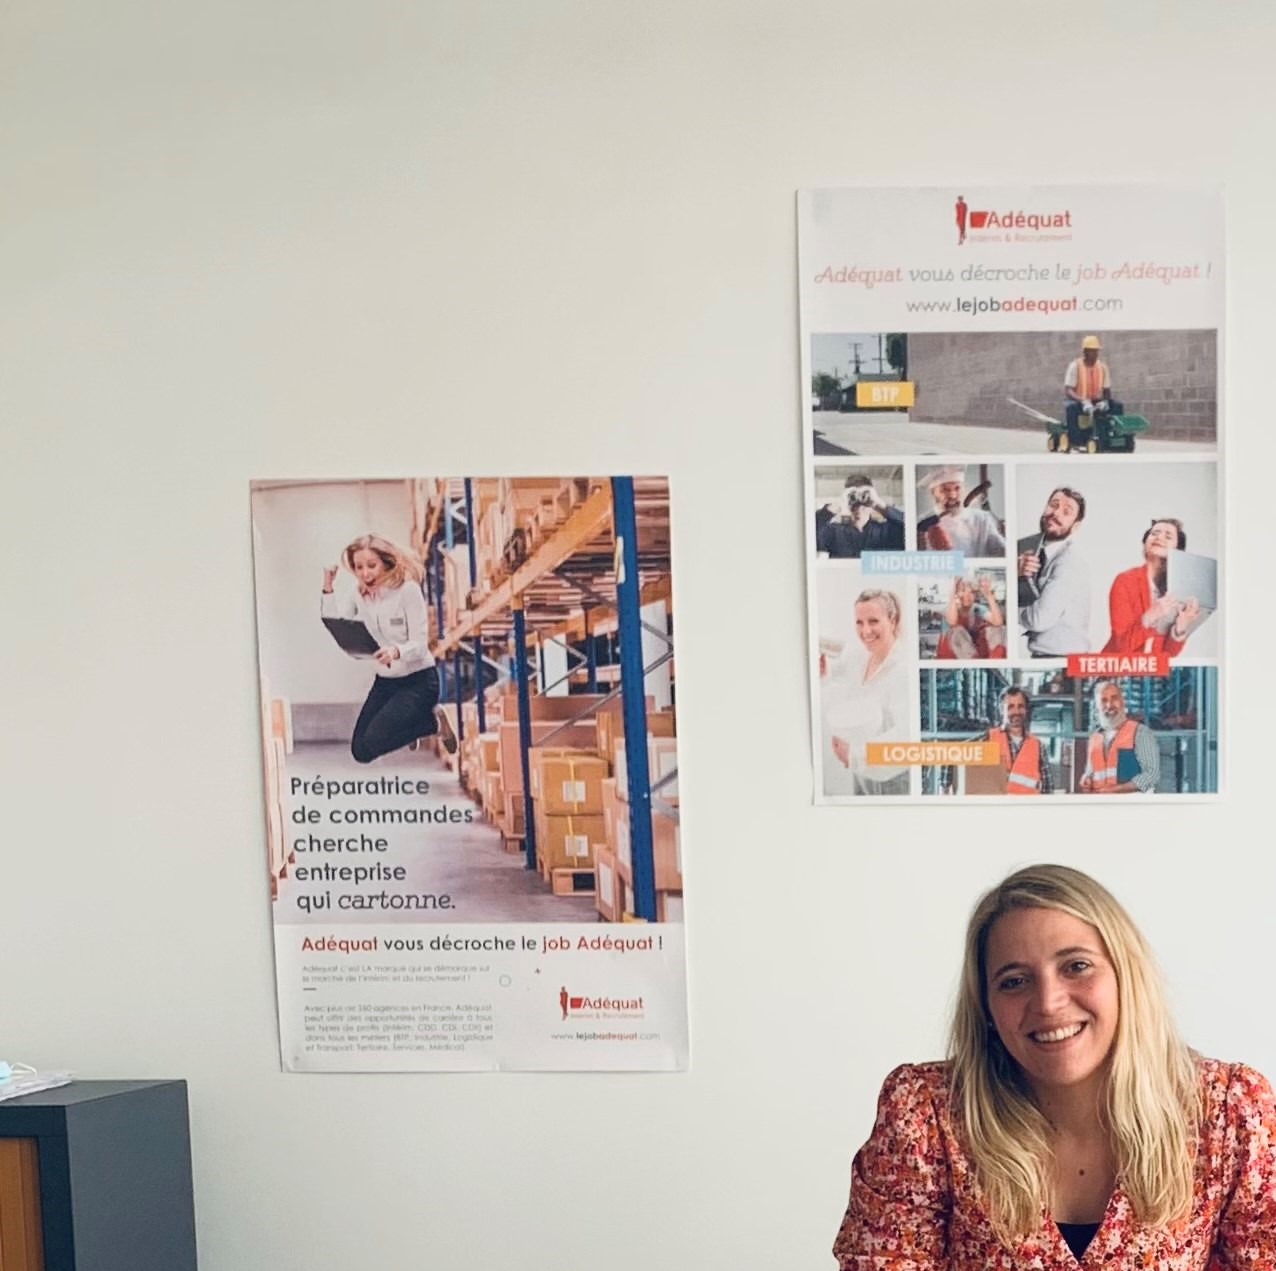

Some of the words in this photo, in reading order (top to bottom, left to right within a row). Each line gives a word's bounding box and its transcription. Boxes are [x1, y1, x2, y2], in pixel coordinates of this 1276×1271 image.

[987, 210, 1072, 231] Adéquat
[814, 266, 903, 289] Adéquat
[908, 267, 955, 283] vous
[960, 264, 1050, 283] décroche
[1056, 265, 1071, 281] le
[1072, 265, 1106, 286] job
[1111, 263, 1200, 286] Adéquat
[1206, 263, 1211, 279] !
[906, 297, 1123, 316] www.lejobadequat.com
[872, 386, 899, 403] BTP
[871, 553, 955, 571] INDUSTRIE
[1079, 656, 1157, 673] TERTIAIRE
[883, 745, 983, 762] LOGISTIQUE
[291, 775, 430, 799] Préparatrice
[292, 805, 321, 824] de
[329, 805, 473, 824] commandes
[293, 834, 388, 852] cherche
[295, 862, 407, 885] entreprise
[297, 891, 331, 913] qui
[338, 890, 456, 910] cartonne.
[302, 935, 378, 954] Adéquat
[384, 938, 424, 951] vous
[429, 935, 516, 951] décroche
[522, 936, 536, 951] le
[543, 935, 571, 953] job
[577, 934, 653, 954] Adéquat
[658, 936, 663, 951] !
[582, 997, 644, 1011] Adéquat
[551, 1032, 661, 1041] www.lejobadequat.com
